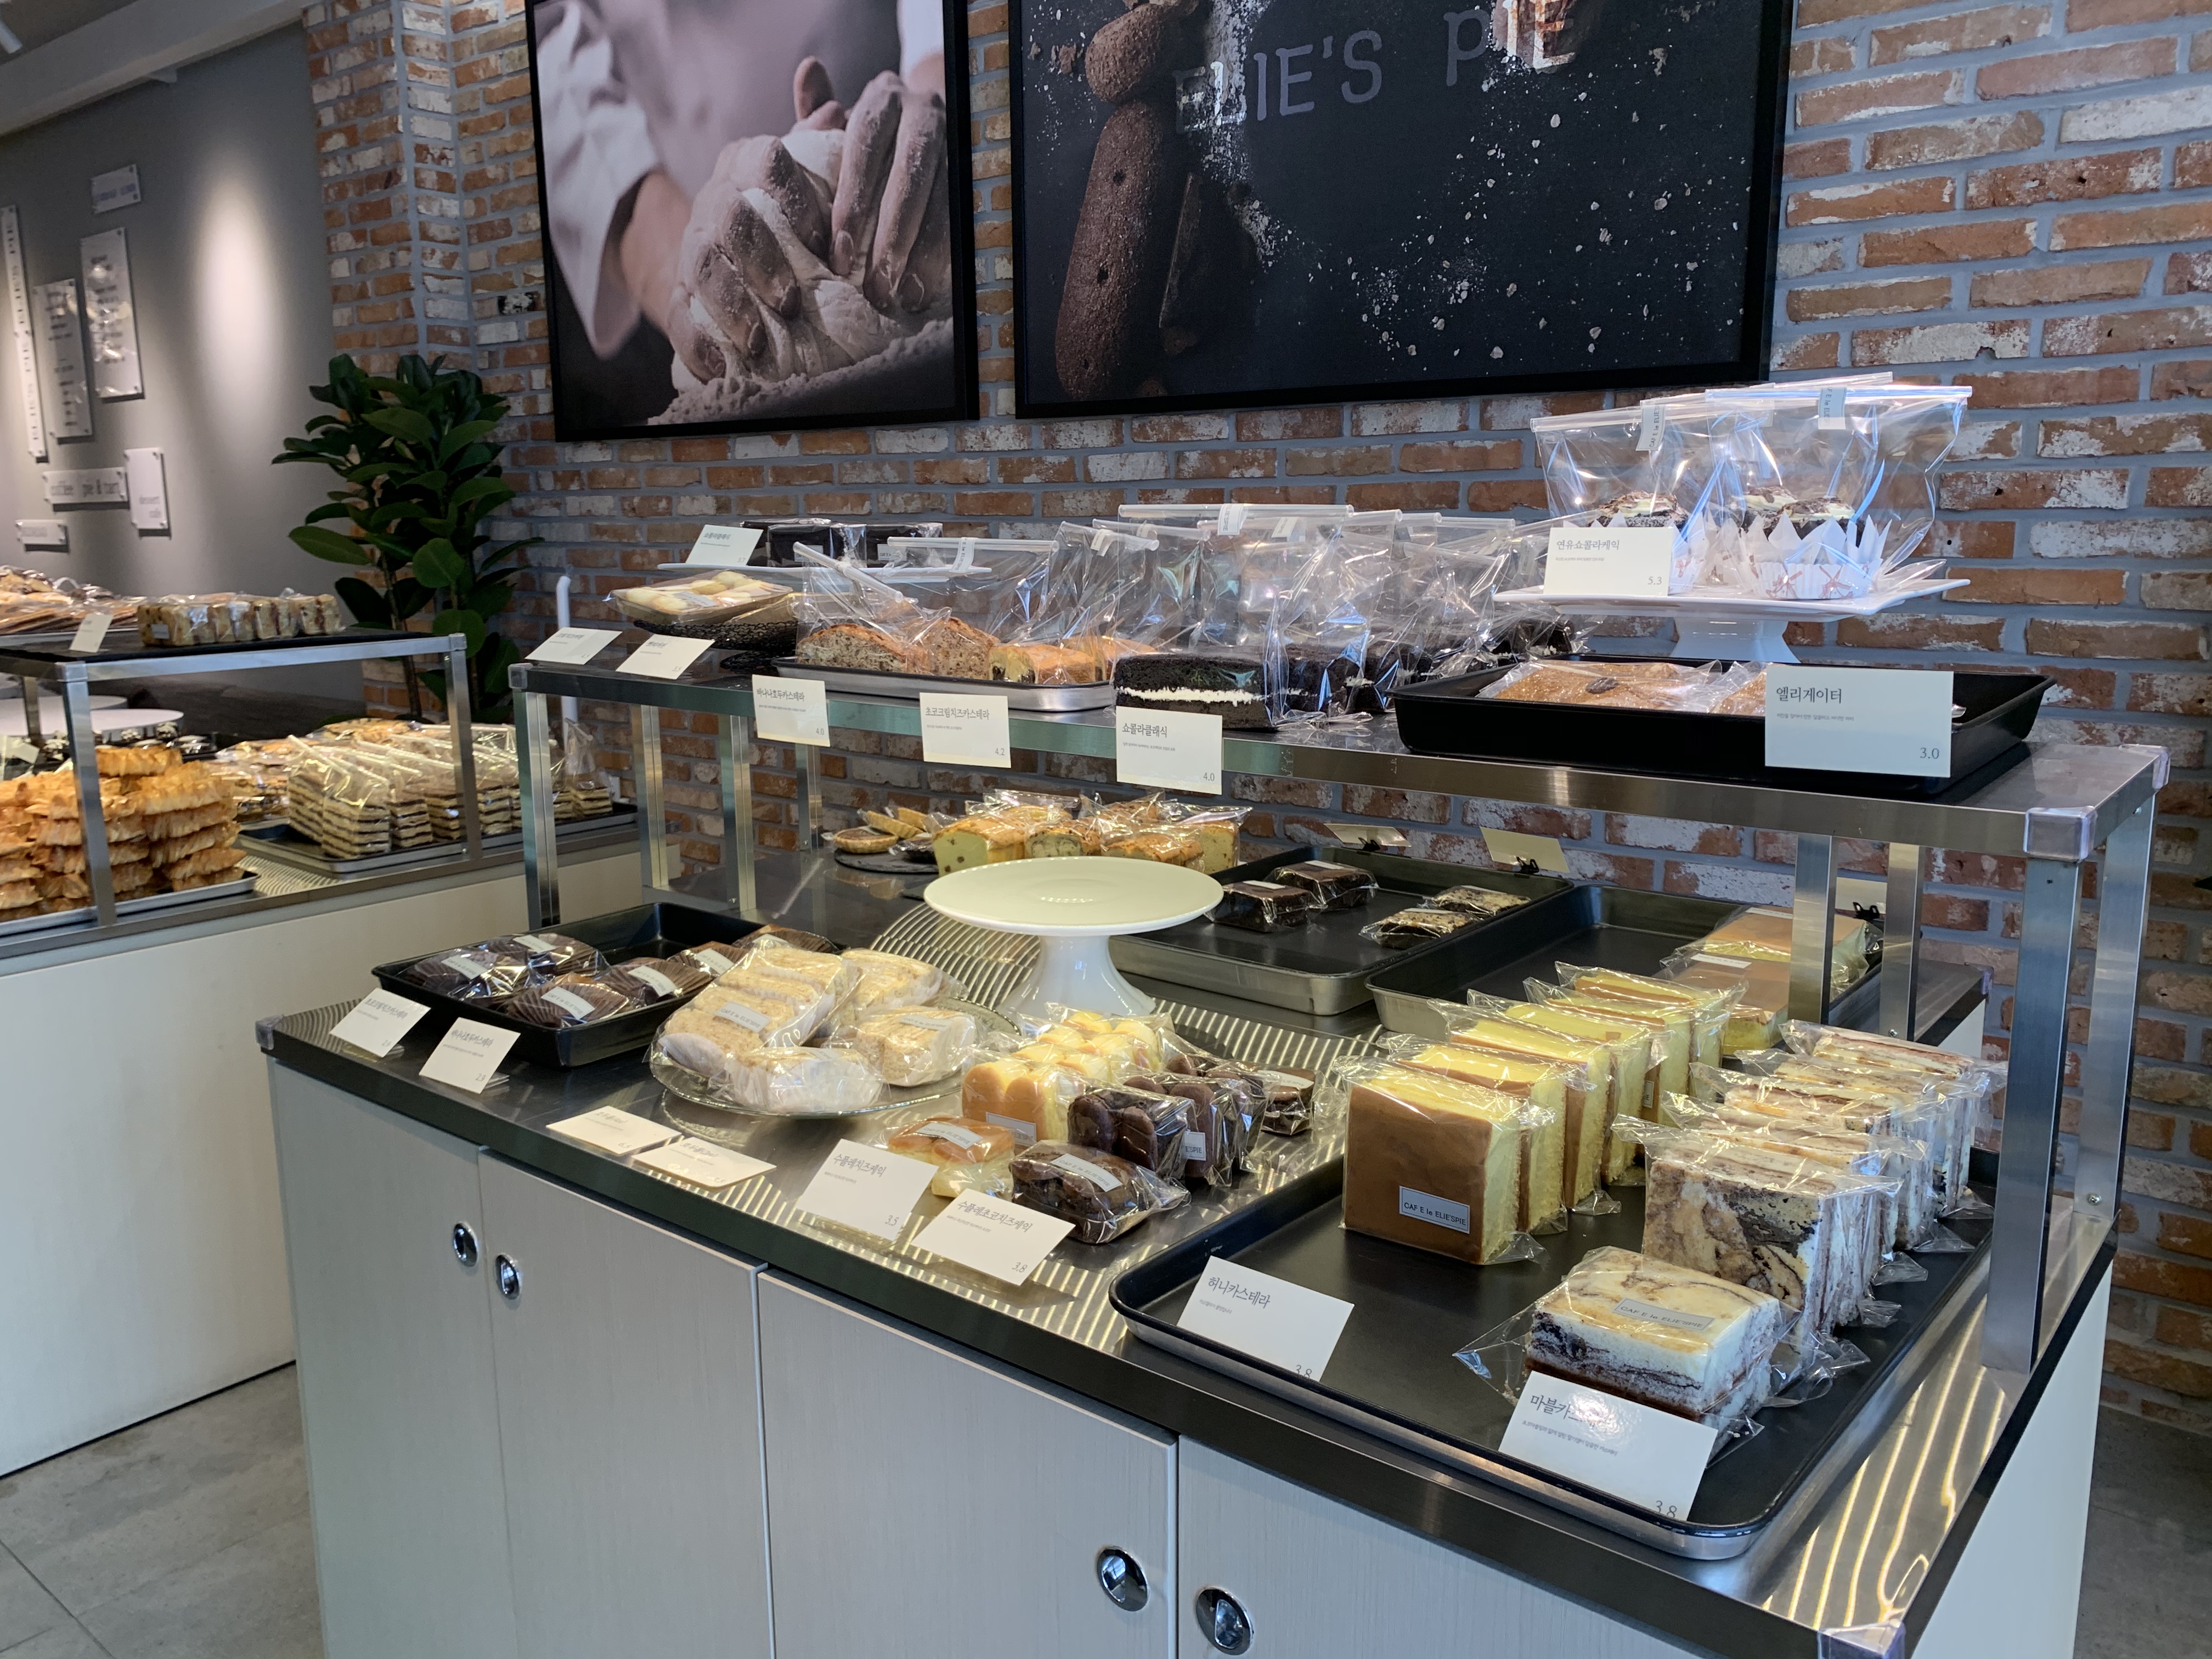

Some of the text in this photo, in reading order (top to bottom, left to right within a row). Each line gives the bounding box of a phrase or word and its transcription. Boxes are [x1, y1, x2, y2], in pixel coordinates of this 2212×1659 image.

[1556, 539, 1620, 551] 연유쇼콜라케익
[1647, 576, 1662, 585] 5.3
[757, 687, 805, 702] 바나나호두카스테라
[1776, 686, 1843, 704] 엘리게이터
[925, 707, 990, 721] 초코크림치즈카스테라
[1122, 723, 1168, 738] 쇼콜라클래식
[995, 748, 1006, 756] 4.2
[1920, 747, 1940, 760] 3.0
[1203, 772, 1215, 782] 4.0
[833, 1154, 887, 1177] 수플레치즈케익
[1404, 1202, 1418, 1211] CAF
[884, 1214, 900, 1227] 3.5
[957, 1200, 1034, 1233] 수플레초코치즈케익
[1011, 1262, 1028, 1273] 3.8
[1208, 1277, 1271, 1309] 허니카스테라
[1620, 1306, 1640, 1314] CAF
